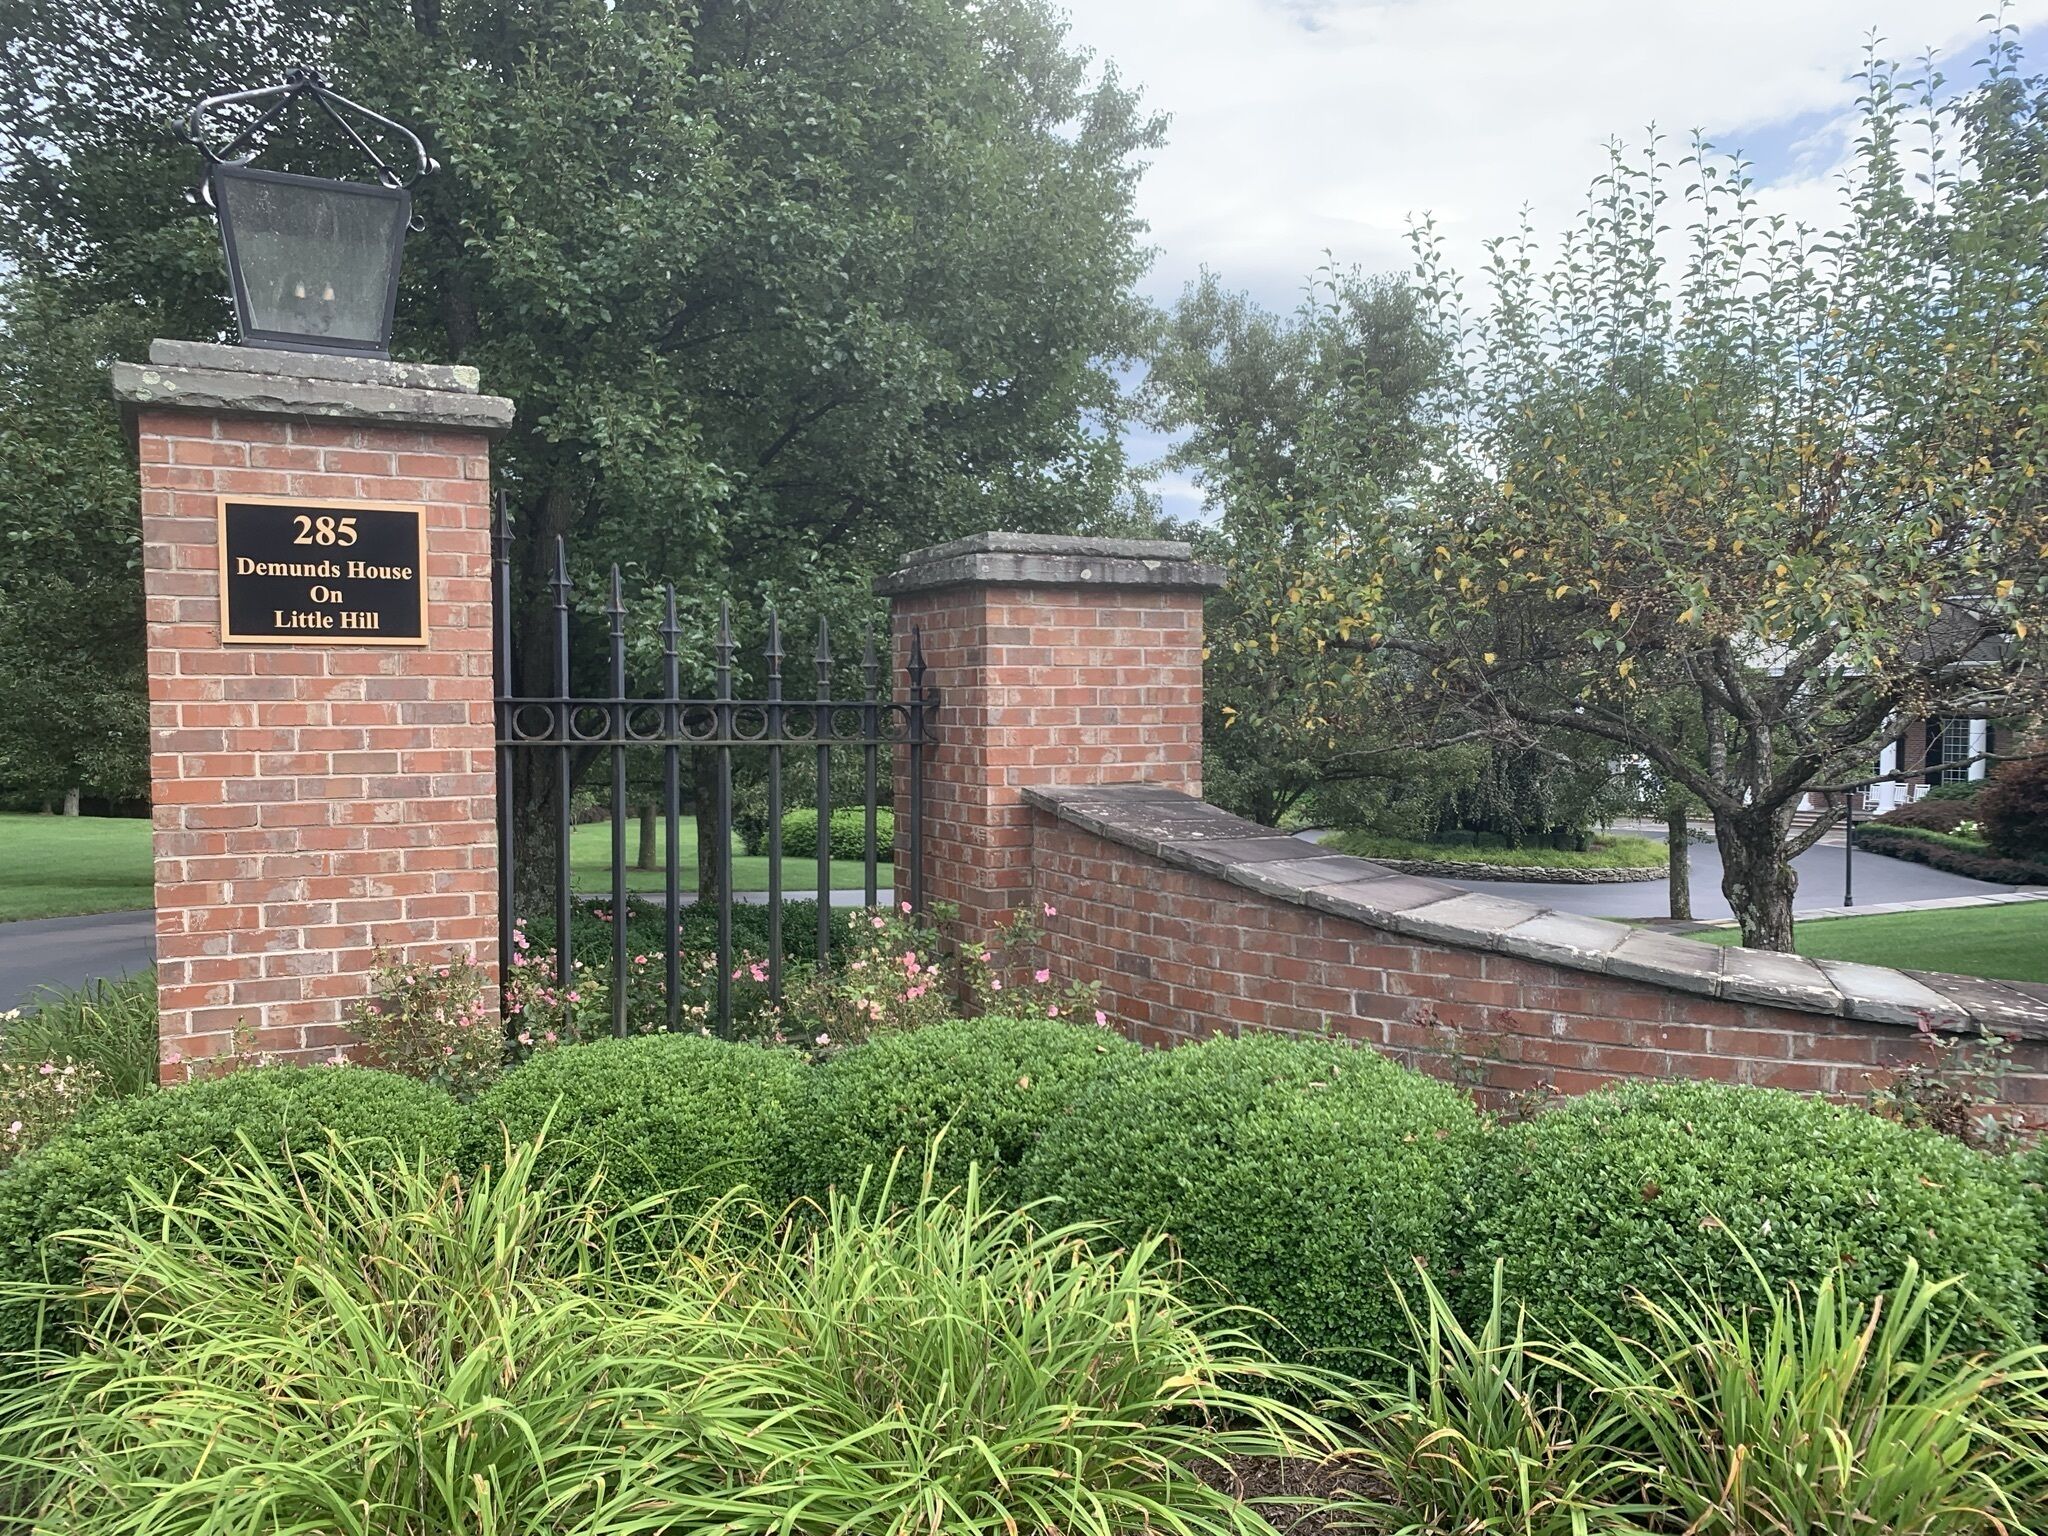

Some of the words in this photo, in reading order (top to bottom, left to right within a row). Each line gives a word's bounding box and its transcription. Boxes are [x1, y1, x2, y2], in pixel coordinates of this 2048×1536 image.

[293, 515, 358, 547] 285
[236, 557, 341, 578] Demunds
[347, 560, 413, 580] House
[310, 585, 344, 603] On
[274, 610, 334, 629] Little
[339, 611, 380, 630] Hill
